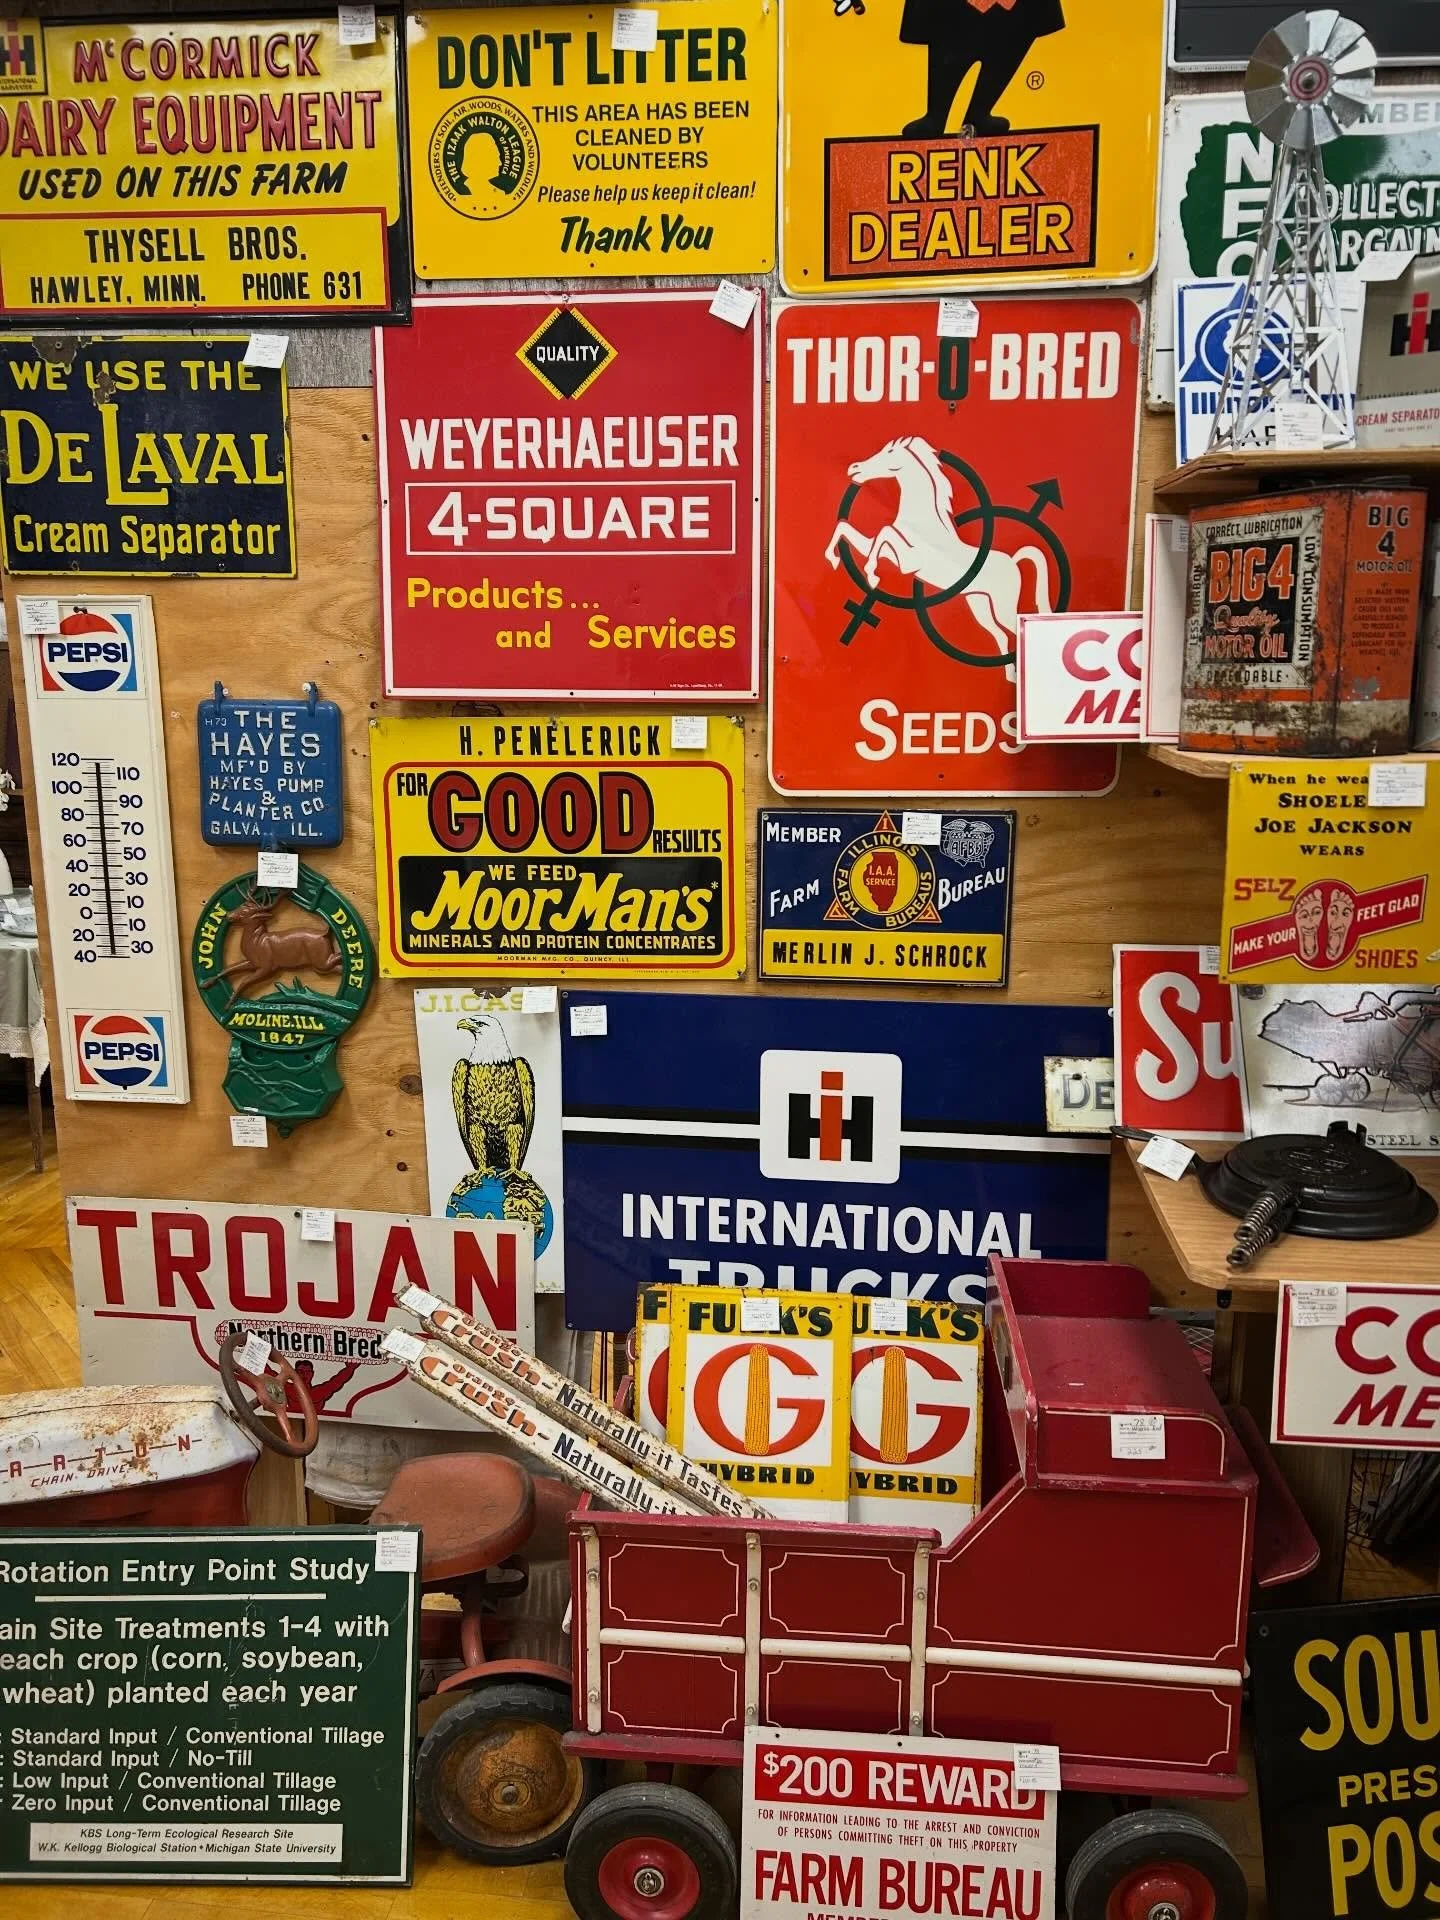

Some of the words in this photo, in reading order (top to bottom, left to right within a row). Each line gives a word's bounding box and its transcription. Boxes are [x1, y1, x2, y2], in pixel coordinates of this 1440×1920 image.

[437, 29, 572, 90] DON'T
[132, 90, 382, 155] EQUIPMENT
[531, 105, 579, 123] THIS
[585, 104, 640, 122] AREA
[646, 102, 688, 121] HAS
[694, 100, 750, 119] BEEN
[467, 115, 510, 135] WALTON
[507, 134, 522, 179] LEAGUE
[575, 127, 672, 147] CLEANED
[678, 126, 705, 144] BY
[572, 151, 709, 171] VOLUNTEERS
[887, 143, 1049, 204] RENK
[18, 167, 101, 200] USED
[116, 165, 162, 199] ON
[172, 163, 242, 198] THIS
[250, 160, 348, 196] FARM
[537, 186, 590, 203] Please
[593, 184, 628, 207] help
[630, 187, 649, 201] us
[651, 182, 690, 205] keep
[705, 181, 756, 199] clean!
[84, 227, 205, 264] THYSELL
[228, 225, 307, 262] BROS.
[559, 215, 653, 254] Thank
[659, 213, 714, 253] You
[848, 201, 1074, 264] DEALER
[30, 275, 132, 305] HAWLEY,
[143, 273, 207, 302] MINN.
[242, 271, 310, 301] PHONE
[323, 270, 362, 300] 631
[535, 345, 600, 364] QUALITY
[9, 360, 68, 391] WE
[85, 360, 167, 391] USE
[180, 360, 262, 391] THE
[1355, 412, 1388, 427] CREAM
[400, 414, 740, 470] WEYERHAEUSER
[427, 491, 711, 547] 4-SQUARE
[1243, 515, 1303, 535] LUBRICATION
[1367, 505, 1409, 528] BIG
[13, 514, 109, 554] Cream
[120, 515, 281, 562] Separator
[1377, 530, 1397, 557] 4
[1208, 547, 1267, 604] BIG
[1267, 543, 1295, 600] 4
[1356, 560, 1395, 572] MOTOR
[1396, 559, 1413, 572] OIL
[1299, 567, 1316, 661] CONSUMPTION
[495, 620, 552, 649] and
[587, 614, 737, 650] Services
[1259, 632, 1289, 659] OIL
[47, 642, 128, 663] PEPSI
[234, 710, 297, 730] THE
[210, 731, 321, 758] HAYES
[459, 725, 484, 756] H.
[494, 725, 661, 757] PENELERICK
[51, 752, 80, 767] 120
[116, 766, 140, 781] 110
[1249, 773, 1296, 785] When
[1306, 773, 1326, 785] he
[51, 780, 83, 795] 100
[209, 776, 264, 791] HAYES
[277, 778, 324, 793] PUMP
[208, 792, 294, 821] PLANTER
[396, 772, 428, 797] FOR
[427, 770, 655, 855] GOOD
[653, 829, 722, 854] RESULTS
[210, 820, 261, 836] GALVA
[291, 822, 323, 837] ILL.
[766, 822, 842, 843] MEMBER
[1254, 818, 1296, 833] JOE
[1307, 817, 1413, 834] JACKSON
[1298, 844, 1365, 857] WEARS
[488, 864, 516, 882] WE
[527, 864, 576, 882] FEED
[865, 877, 896, 887] SERVICE
[770, 878, 820, 918] FARM
[938, 866, 1006, 911] BUREAU
[885, 871, 932, 928] BUREAUS
[1233, 878, 1297, 901] SELZ
[1233, 936, 1264, 956] MAKE
[1266, 926, 1296, 946] YOUR
[1357, 904, 1385, 923] FEET
[1387, 893, 1419, 914] GLAD
[198, 902, 227, 970] JOHN
[330, 908, 363, 989] DEERE
[409, 934, 492, 949] MINERALS
[499, 934, 531, 949] AND
[536, 935, 600, 949] PROTEIN
[606, 935, 716, 950] CONCENTRATES
[772, 941, 853, 965] MERLIN
[864, 943, 885, 966] J.
[895, 944, 988, 969] SCHROCK
[1354, 948, 1419, 970] SHOES
[84, 1041, 160, 1062] PEPSI
[259, 1031, 305, 1045] 1847
[1366, 1134, 1422, 1147] STEEL
[622, 1193, 1042, 1259] INTERNATIONAL
[76, 1208, 517, 1332] TROJAN
[688, 1301, 833, 1337] FUK'S
[333, 1330, 382, 1359] Bred
[700, 1462, 815, 1485] HYBRID
[679, 1459, 743, 1517] Tastes
[0, 1561, 109, 1585] Rotation
[122, 1559, 195, 1587] Entry
[207, 1557, 277, 1582] Point
[288, 1556, 370, 1585] Study
[49, 1616, 103, 1641] Site
[114, 1615, 266, 1640] Treatments
[278, 1615, 322, 1638] 1-4
[335, 1614, 390, 1638] with
[76, 1651, 139, 1677] crop
[150, 1644, 230, 1673] (corn,
[241, 1645, 365, 1677] soybean,
[3, 1679, 96, 1706] wheat)
[107, 1679, 210, 1709] planted
[299, 1684, 358, 1707] year
[10, 1727, 100, 1745] Standard
[108, 1727, 158, 1748] Input
[185, 1726, 313, 1746] Conventional
[321, 1726, 385, 1748] Tillage
[187, 1748, 253, 1768] No-Till
[12, 1772, 52, 1789] Low
[762, 1751, 853, 1799] $200
[868, 1760, 1038, 1811] REWARD
[1338, 1764, 1438, 1808] PRES
[12, 1794, 57, 1812] Zero
[164, 1827, 218, 1841] Ecological
[222, 1827, 270, 1839] Research
[779, 1810, 838, 1825] INFORMATION
[843, 1814, 881, 1828] LEADING
[924, 1820, 958, 1833] ARREST
[987, 1824, 1040, 1839] CONVICTION
[63, 1842, 102, 1855] Kellogg
[160, 1842, 198, 1853] Station
[205, 1842, 250, 1855] Michigan
[286, 1842, 337, 1856] University
[794, 1827, 833, 1841] PERSONS
[838, 1830, 893, 1845] COMMITTING
[898, 1834, 924, 1847] THEFT
[948, 1837, 968, 1850] THIS
[972, 1839, 1018, 1853] PROPERTY
[755, 1849, 864, 1907] FARM
[878, 1857, 1042, 1920] BUREAU
